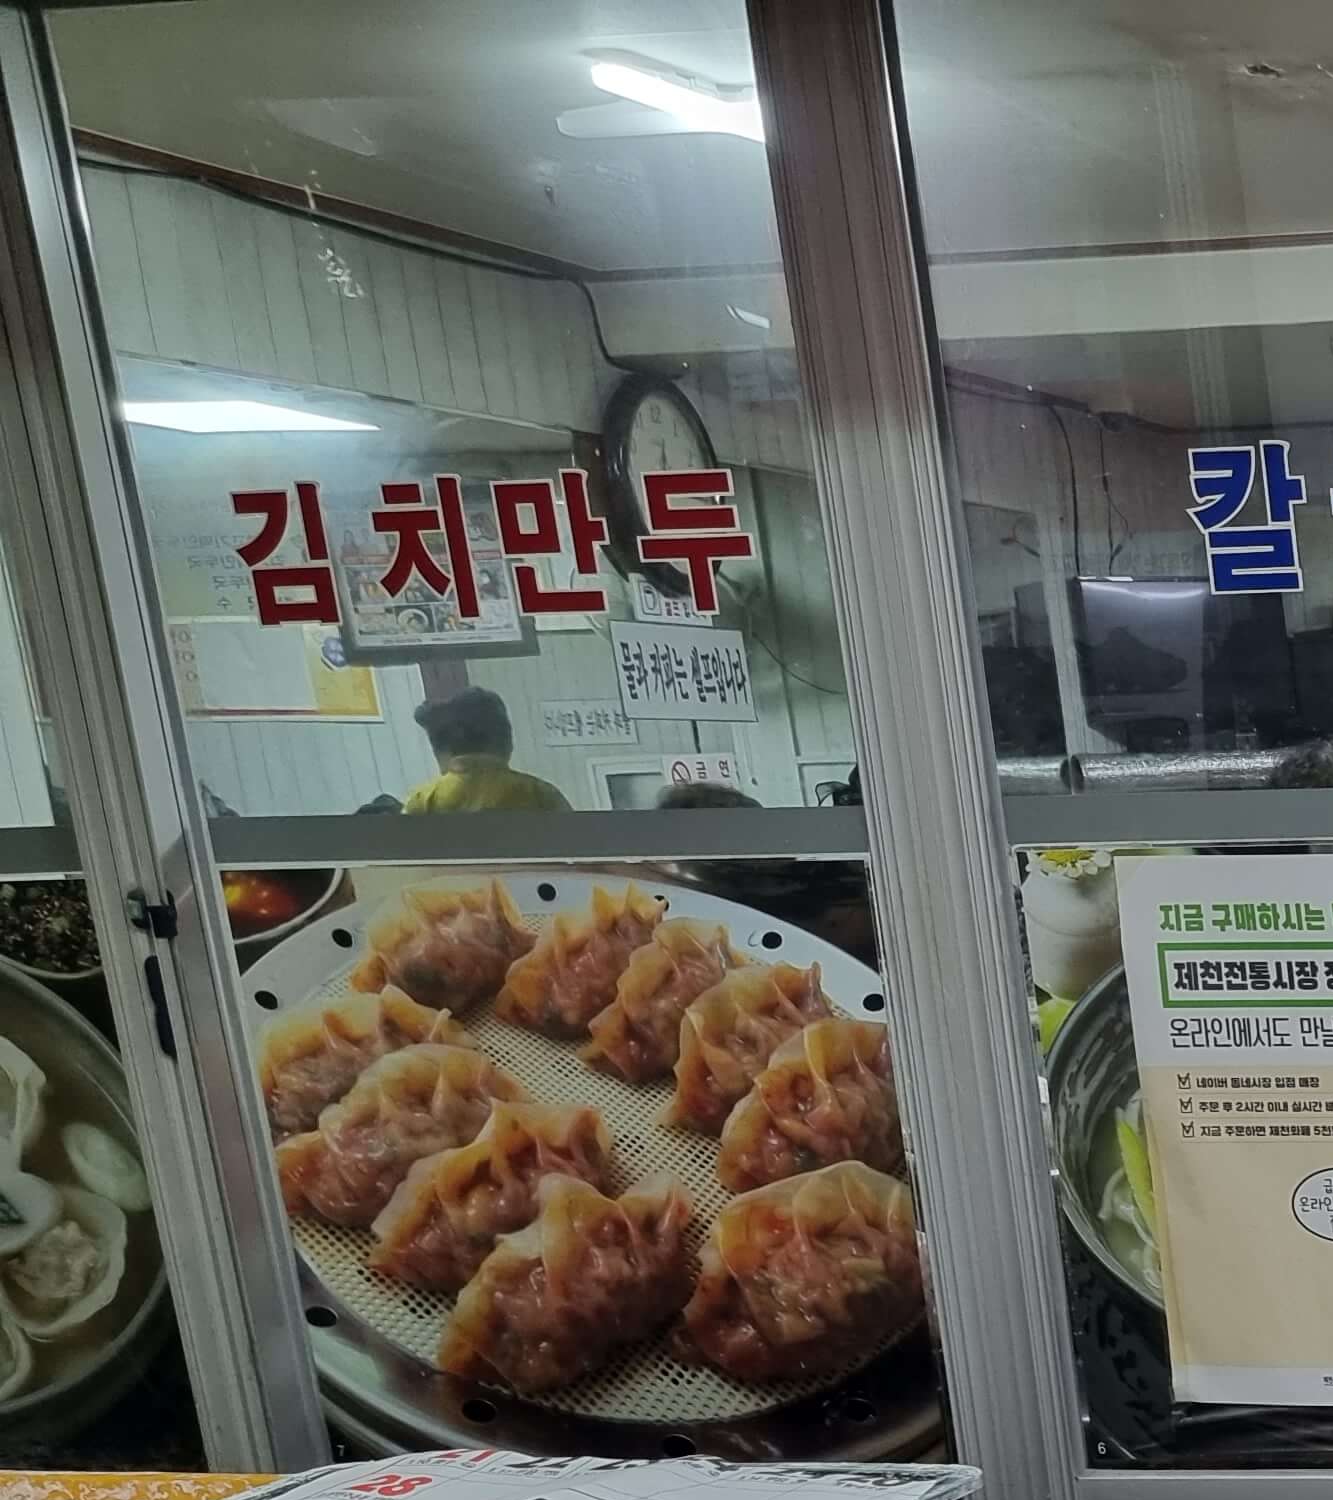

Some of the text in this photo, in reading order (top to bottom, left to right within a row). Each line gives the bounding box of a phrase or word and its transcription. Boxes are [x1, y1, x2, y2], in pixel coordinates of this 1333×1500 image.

[230, 468, 754, 628] 김치만두
[1159, 903, 1205, 932] 지금
[1211, 902, 1326, 931] 구매하시는
[1173, 960, 1318, 991] 제천전통시장
[1169, 1018, 1292, 1049] 온라인에서도
[1196, 1077, 1228, 1088] 네이버
[1231, 1077, 1271, 1088] 동네시장
[1199, 1101, 1219, 1113] 주문
[1236, 1101, 1264, 1113] 2시간
[1267, 1101, 1289, 1113] 이내
[1200, 1126, 1221, 1137] 지금
[1098, 1442, 1106, 1454] 6
[352, 1474, 433, 1497] 28
